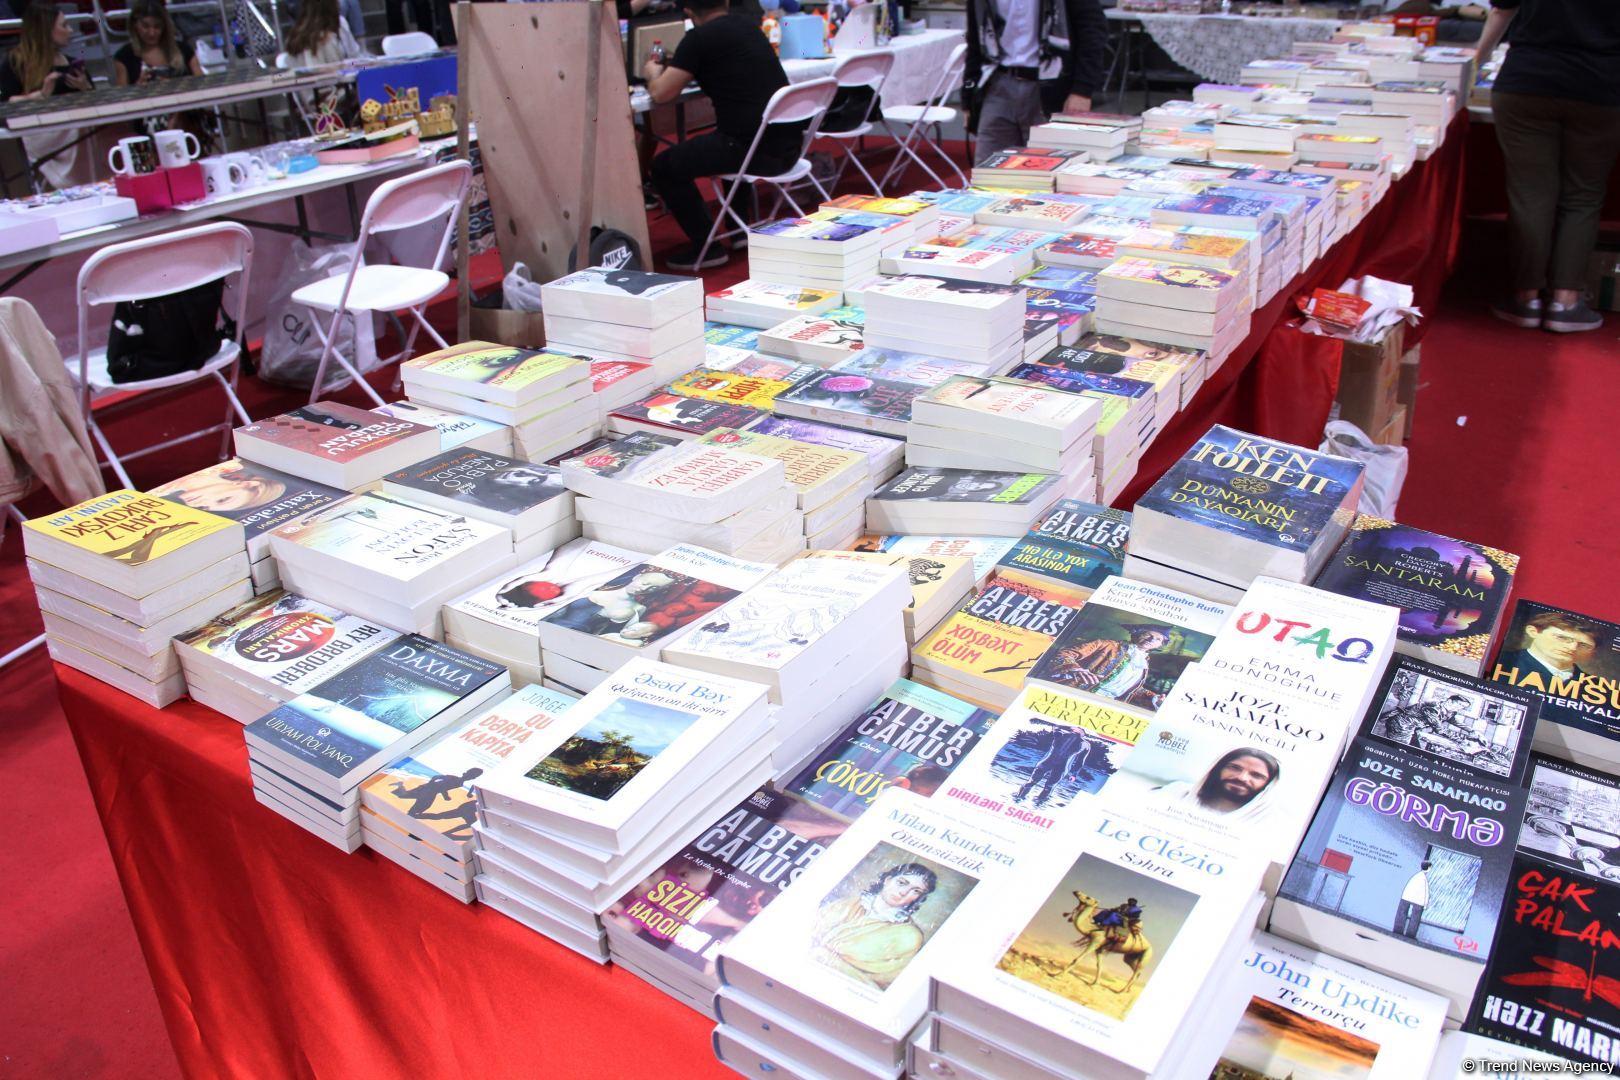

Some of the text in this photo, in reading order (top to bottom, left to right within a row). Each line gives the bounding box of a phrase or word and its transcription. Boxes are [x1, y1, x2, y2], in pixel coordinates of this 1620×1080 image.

[604, 247, 628, 265] NIKE
[327, 421, 415, 457] QORXULU
[1232, 438, 1318, 473] KEN
[423, 455, 493, 484] NERUDA
[442, 459, 510, 489] PABLO
[1192, 442, 1338, 496] FOLLETT
[241, 489, 325, 526] Xatirələr
[1169, 491, 1290, 534] DAYAQLARI
[1180, 478, 1299, 523] DÜNYANIN
[1039, 519, 1128, 549] CAMUS
[1048, 510, 1131, 538] ALBER
[1012, 552, 1073, 574] ARASINDA
[1020, 544, 1040, 556] HƏ
[1042, 545, 1064, 561] İLƏ
[1064, 552, 1090, 568] YOX
[1394, 560, 1444, 579] ROBERTS
[1399, 552, 1448, 569] GREGORY
[1405, 558, 1437, 571] DAVID
[1342, 554, 1486, 602] ŞANTARAM
[981, 586, 1074, 623] ALBER
[1111, 580, 1226, 616] Jean-Christophe Rufin
[354, 624, 382, 645] REY
[509, 615, 540, 628] MEYER
[970, 600, 1067, 638] CAMUS
[1235, 610, 1375, 665] UTAQ
[252, 618, 335, 664] MARS
[931, 637, 982, 665] ÖLÜM
[945, 622, 1024, 656] XOŞBƏXT
[271, 638, 355, 687] BREDBERİ
[387, 645, 473, 688] DAXMA
[1213, 658, 1346, 704] DONOGHUE
[1248, 656, 1317, 684] EMMA
[1401, 659, 1427, 672] ERAST
[521, 691, 567, 714] JORGE
[633, 672, 688, 695] Əsəd
[687, 683, 734, 706] Bəy
[1224, 690, 1290, 717] JOZE
[523, 713, 555, 731] QU
[682, 698, 701, 713] iki
[701, 704, 730, 718] sirri
[871, 697, 976, 750] ALBER
[1179, 690, 1326, 744] SARAMAQO
[264, 715, 354, 769] UİLYAM POL YANQ
[458, 728, 516, 759] KAPİTA
[477, 714, 536, 744] DƏRYA
[856, 715, 963, 767] CAMUS
[1156, 736, 1188, 751] NOBEL
[812, 758, 893, 805] ÇÖKÜŞ
[1364, 745, 1405, 763] ƏDƏBİYYAT
[1432, 767, 1456, 781] NOBEL
[1457, 777, 1511, 798] MÜKAFATÇISI
[1536, 758, 1564, 771] ERAST
[1359, 756, 1508, 813] JOZE SARAMAQO
[946, 785, 1005, 813] DİRİLƏRİ
[1004, 804, 1056, 830] SAĞALT
[1342, 775, 1505, 847] GÖRMƏ
[715, 807, 828, 871] ALBER
[887, 808, 938, 835] Milan
[938, 828, 1017, 868] Kundera
[890, 828, 987, 875] Ölümsüzlük
[1095, 818, 1130, 842] Le
[1137, 833, 1225, 878] Clézio
[696, 827, 805, 892] CAMUS
[1118, 850, 1174, 879] Səhra
[1517, 869, 1596, 914] ÇAK
[1243, 951, 1421, 1030] John Updike
[1276, 985, 1368, 1031] Terrorçu
[1482, 994, 1546, 1037] HƏZZ
